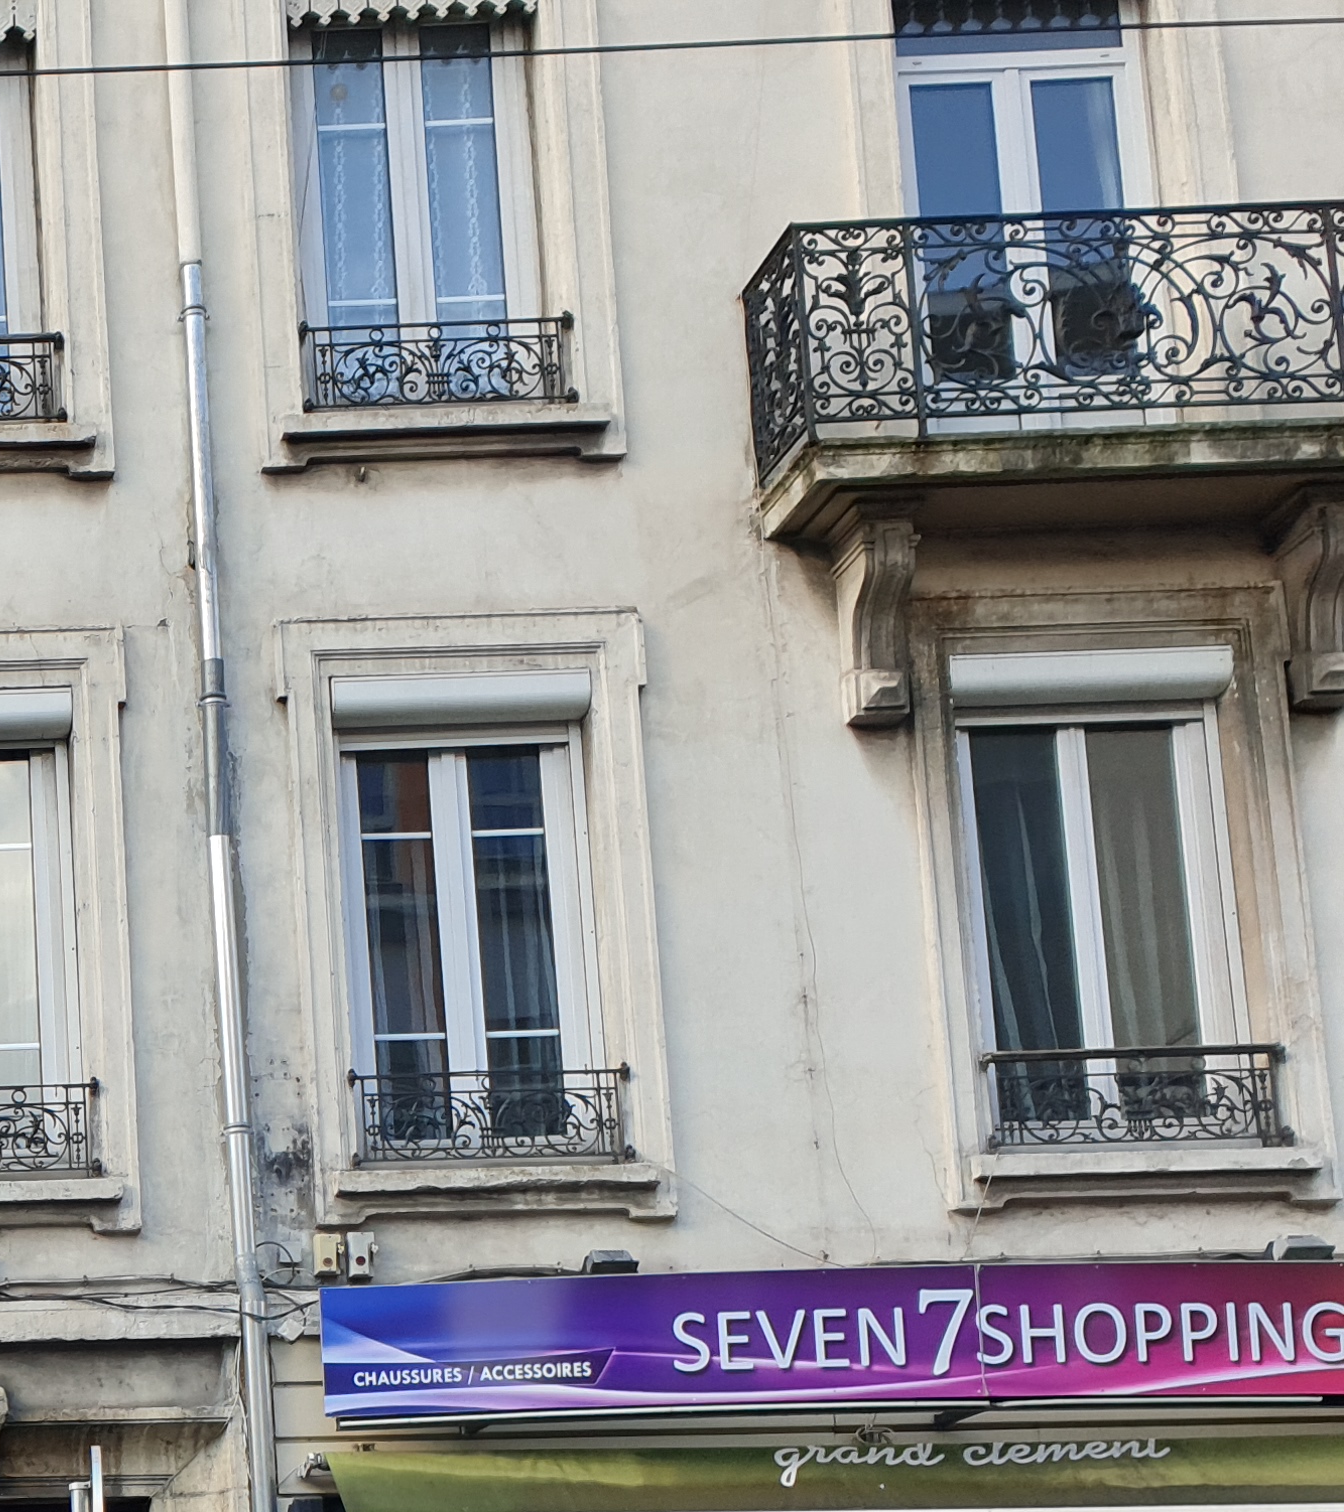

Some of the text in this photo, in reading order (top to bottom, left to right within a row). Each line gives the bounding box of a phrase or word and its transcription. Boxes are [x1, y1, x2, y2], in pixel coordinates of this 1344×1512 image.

[672, 1288, 1344, 1376] SEVEN 7 SHOPPING
[353, 1366, 463, 1388] CHAUSSURES
[479, 1361, 593, 1382] ACCESSOIRES
